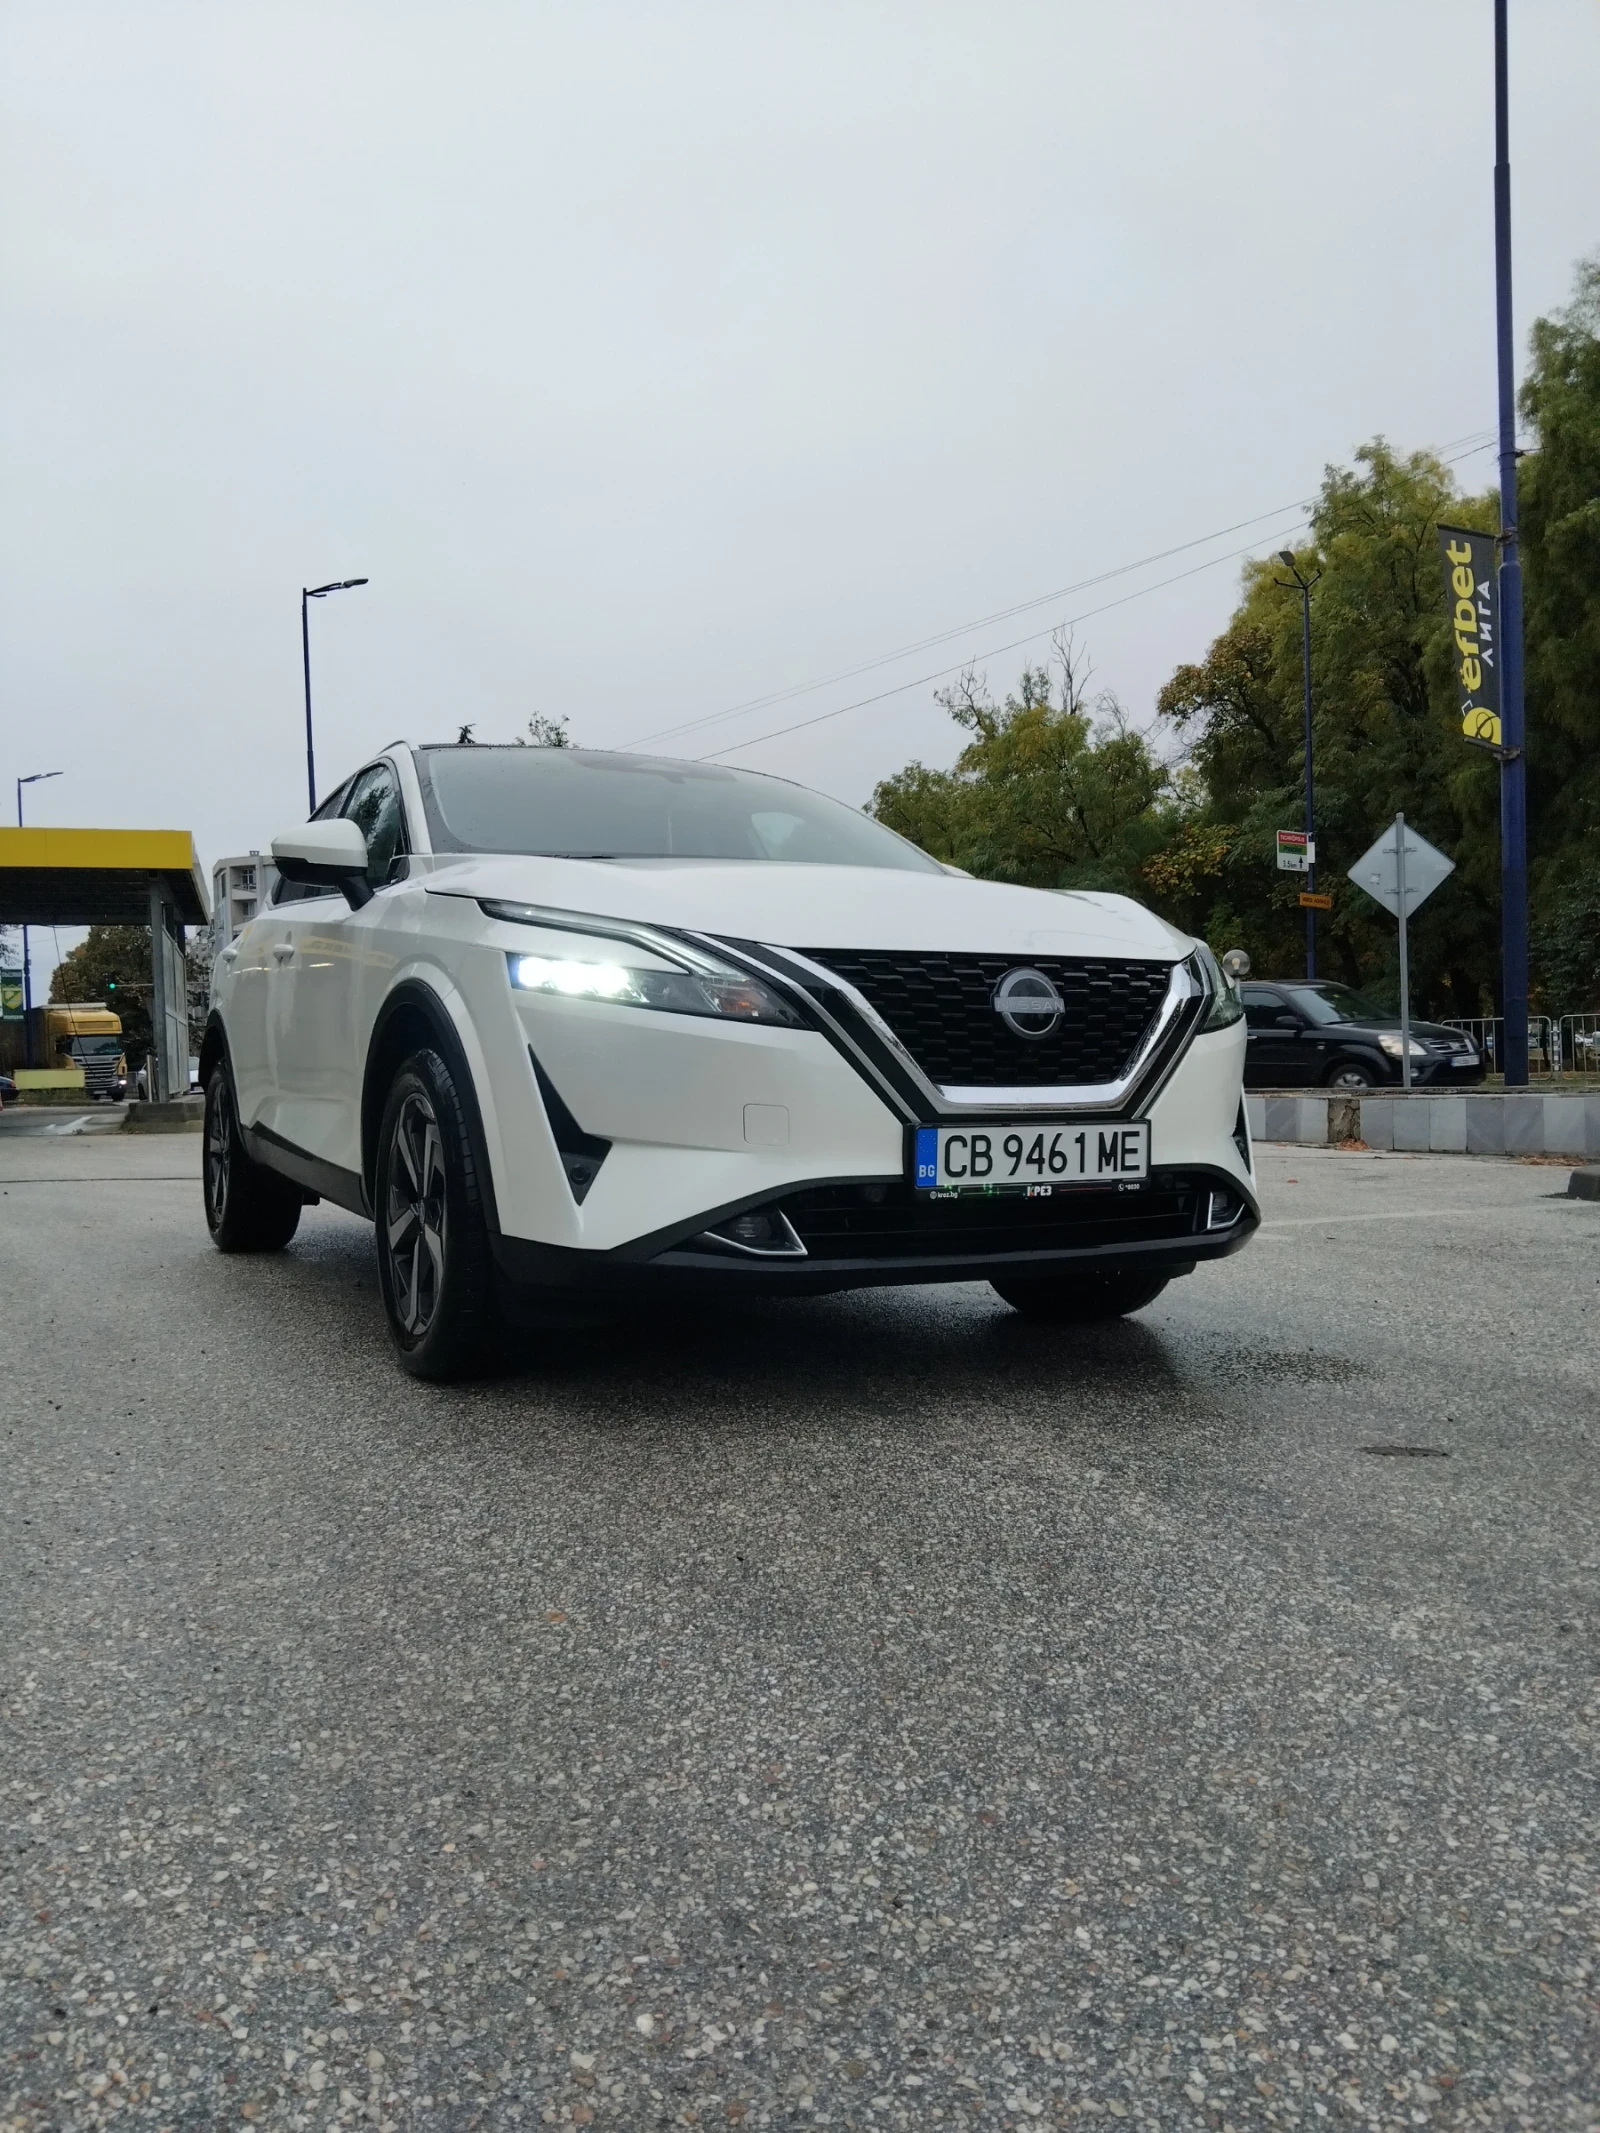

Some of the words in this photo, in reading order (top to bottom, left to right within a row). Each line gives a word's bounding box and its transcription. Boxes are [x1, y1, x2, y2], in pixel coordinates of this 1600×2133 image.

[1446, 540, 1481, 691] efbet
[1476, 580, 1494, 667] ЛИГА
[997, 1000, 1065, 1011] NISSAN
[918, 1164, 936, 1178] BG
[944, 1134, 993, 1178] CB
[1003, 1132, 1086, 1176] 9461
[1098, 1130, 1141, 1173] ME
